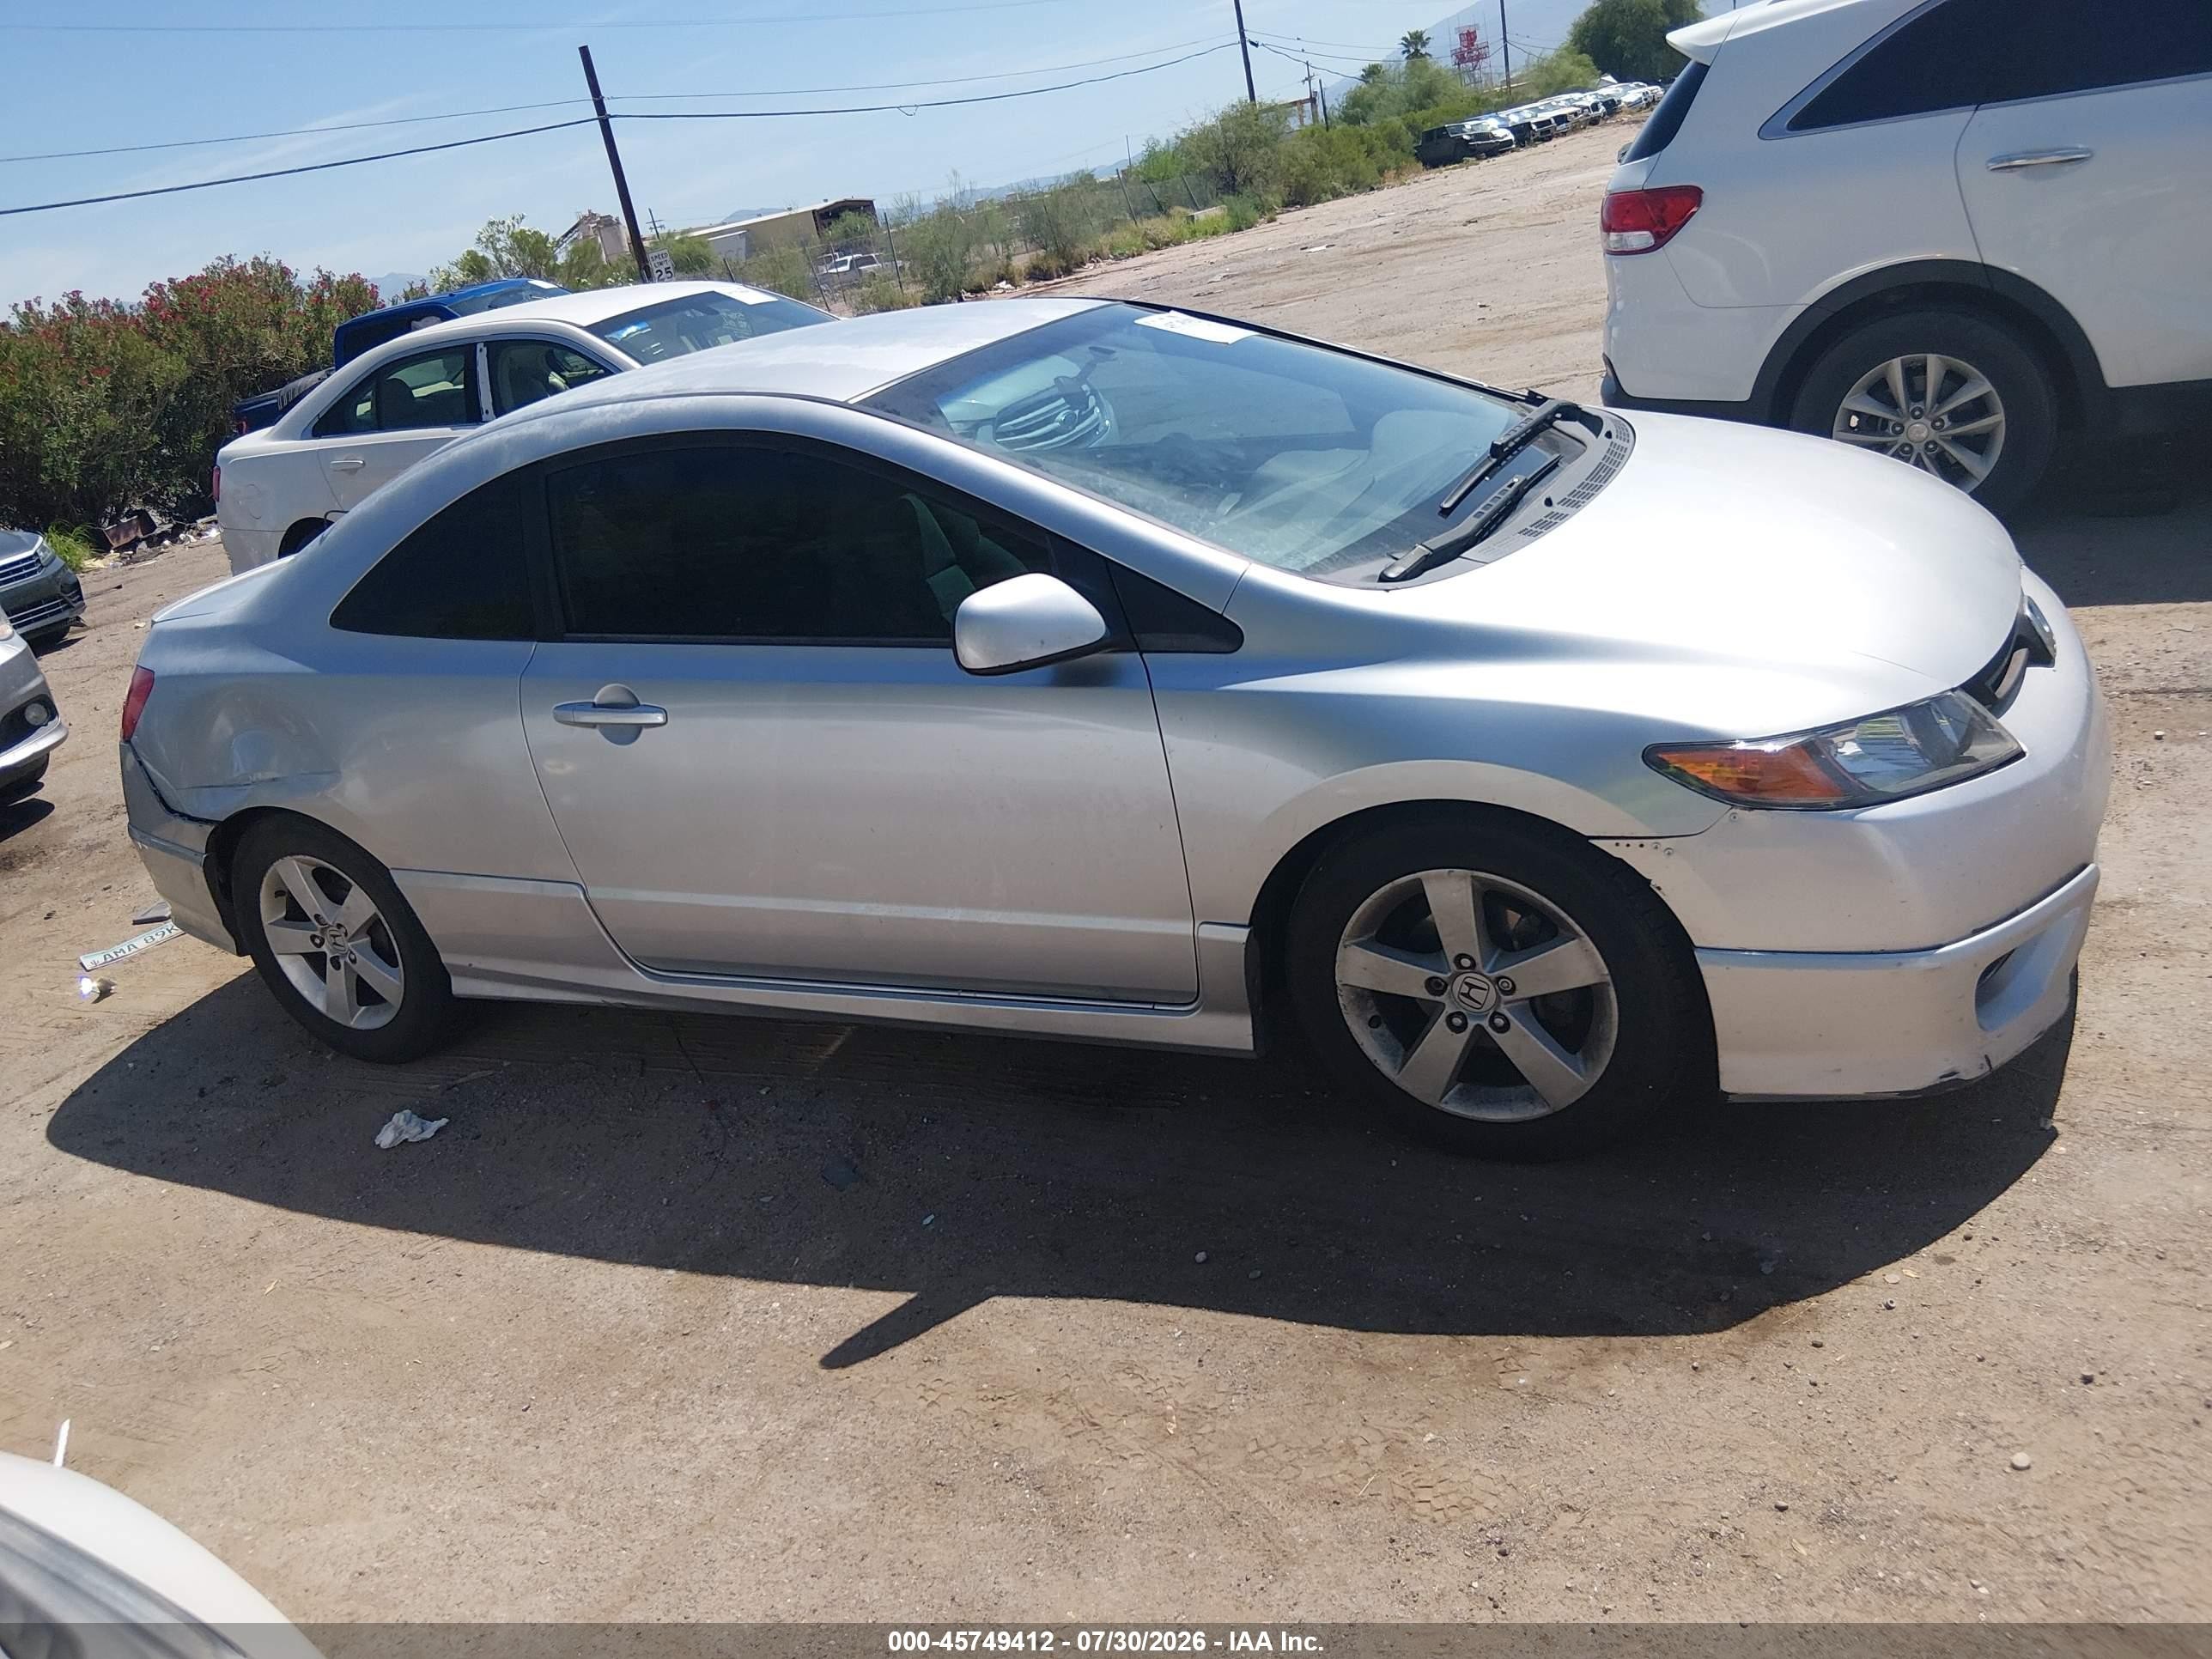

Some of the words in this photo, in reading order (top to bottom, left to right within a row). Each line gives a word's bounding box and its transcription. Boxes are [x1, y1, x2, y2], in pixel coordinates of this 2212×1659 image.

[650, 252, 669, 261] SPEED
[653, 259, 668, 268] LIMIT
[655, 266, 673, 282] 25
[103, 943, 137, 961] AMA
